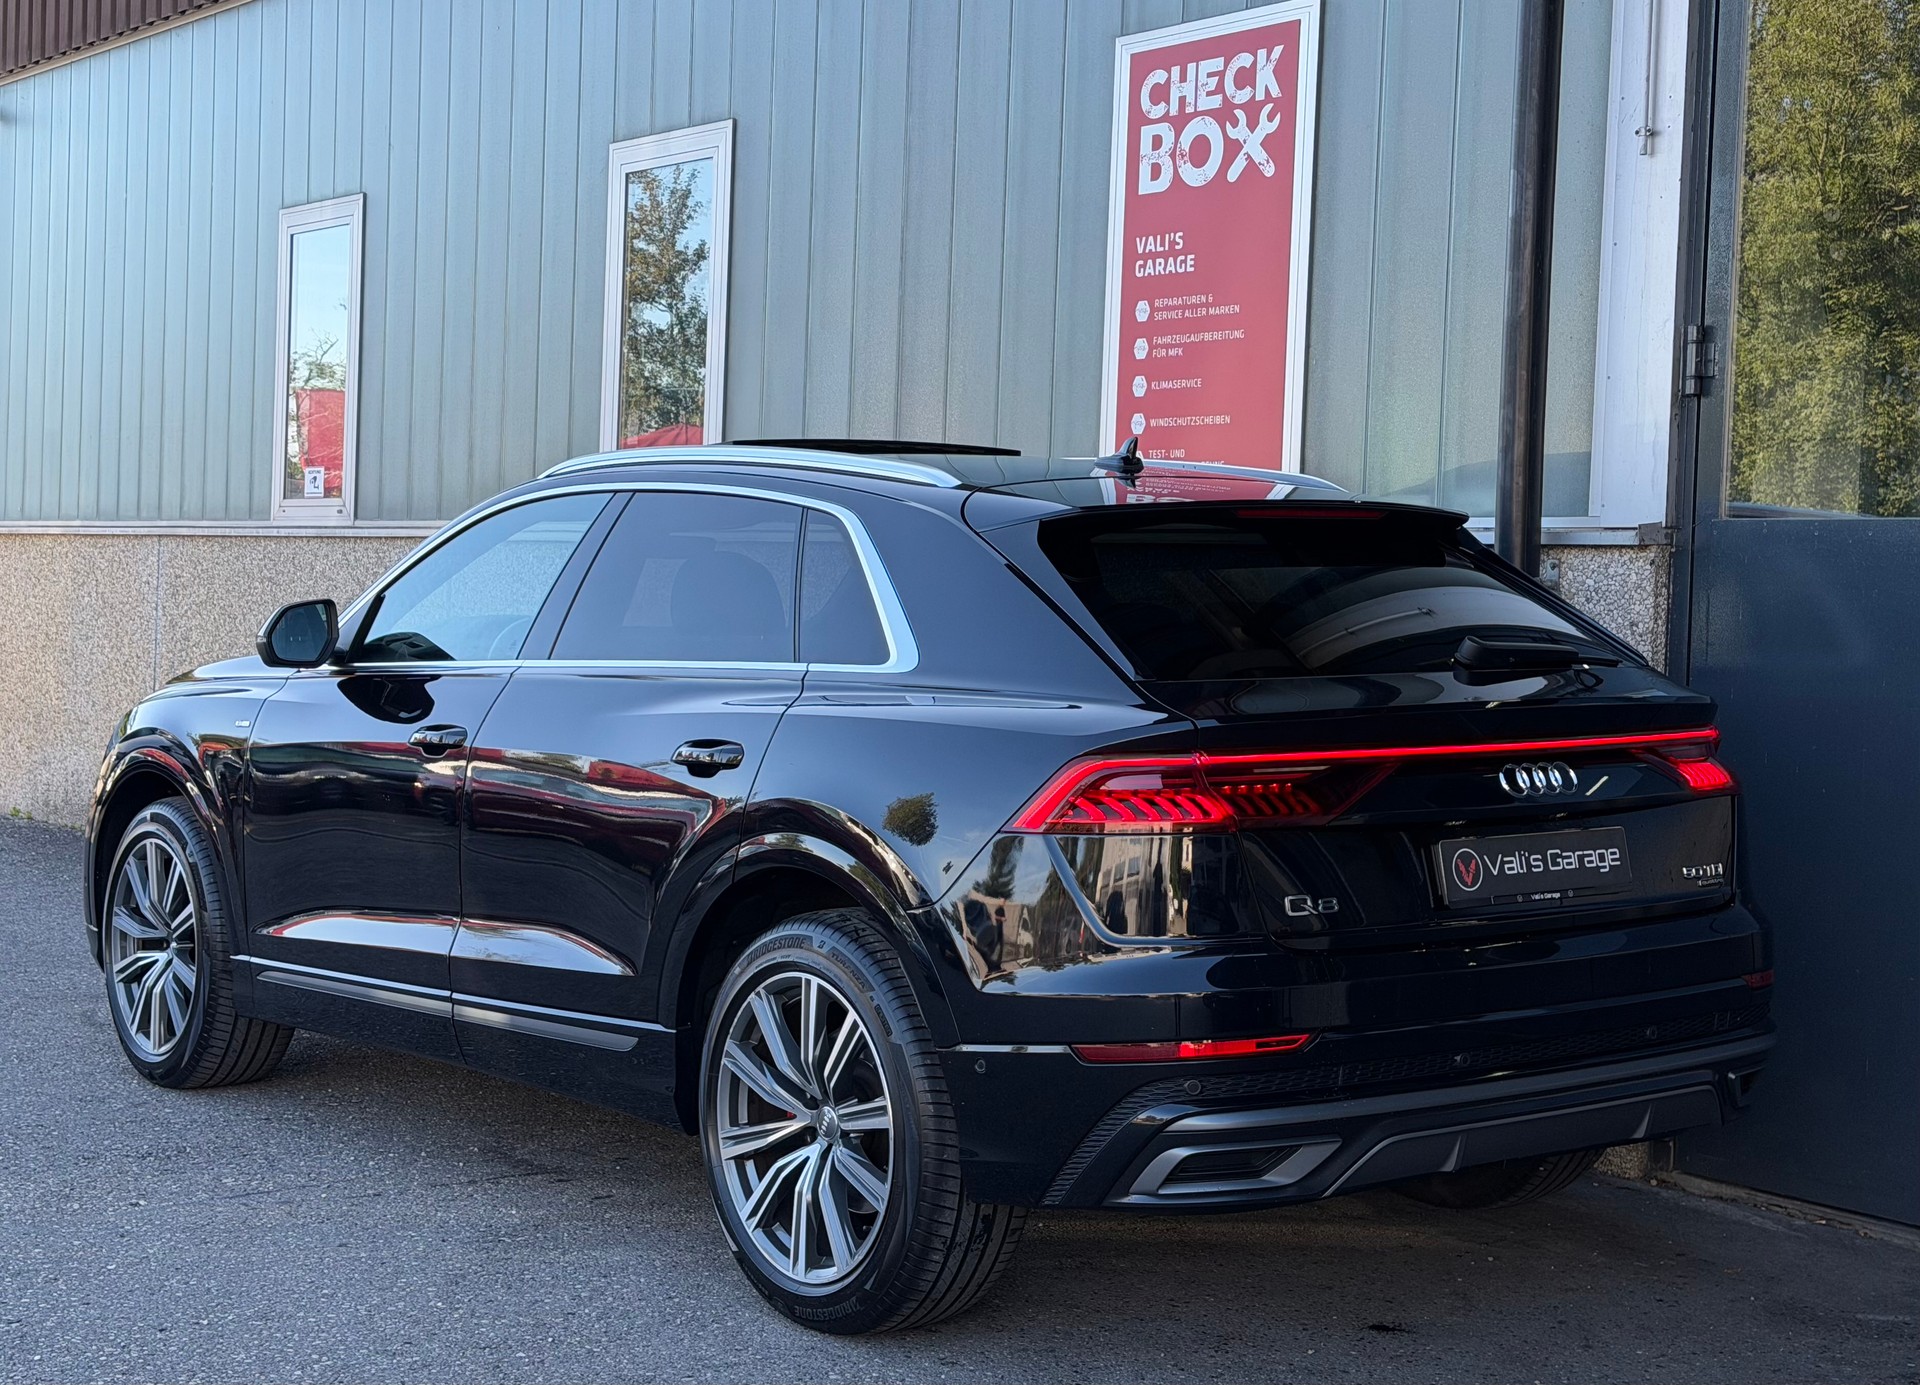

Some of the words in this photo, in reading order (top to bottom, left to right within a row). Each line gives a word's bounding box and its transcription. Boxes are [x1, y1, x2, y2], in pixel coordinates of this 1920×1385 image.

[1140, 44, 1285, 120] CHECK
[1138, 103, 1281, 196] BOX
[1136, 231, 1184, 254] VALI'S
[1135, 254, 1195, 278] GARAGE
[1154, 294, 1207, 308] REPARATUREN
[1207, 293, 1214, 303] &
[1154, 309, 1183, 321] SERVICE
[1184, 307, 1207, 318] ALLER
[1208, 304, 1240, 316] MARKEN
[1153, 329, 1245, 345] FAHRZEUGAUFBEREITUNG
[1152, 347, 1167, 358] FÜR
[1168, 347, 1183, 357] MFK
[1151, 378, 1202, 390] KLIMASERVICE
[1150, 415, 1231, 427] WINDSCHUTZSCHEIBEN
[1149, 450, 1169, 459] TEST-
[1170, 449, 1185, 458] UND
[1483, 850, 1543, 876] Vali's
[1547, 848, 1621, 873] Garage
[1284, 894, 1339, 917] Q8
